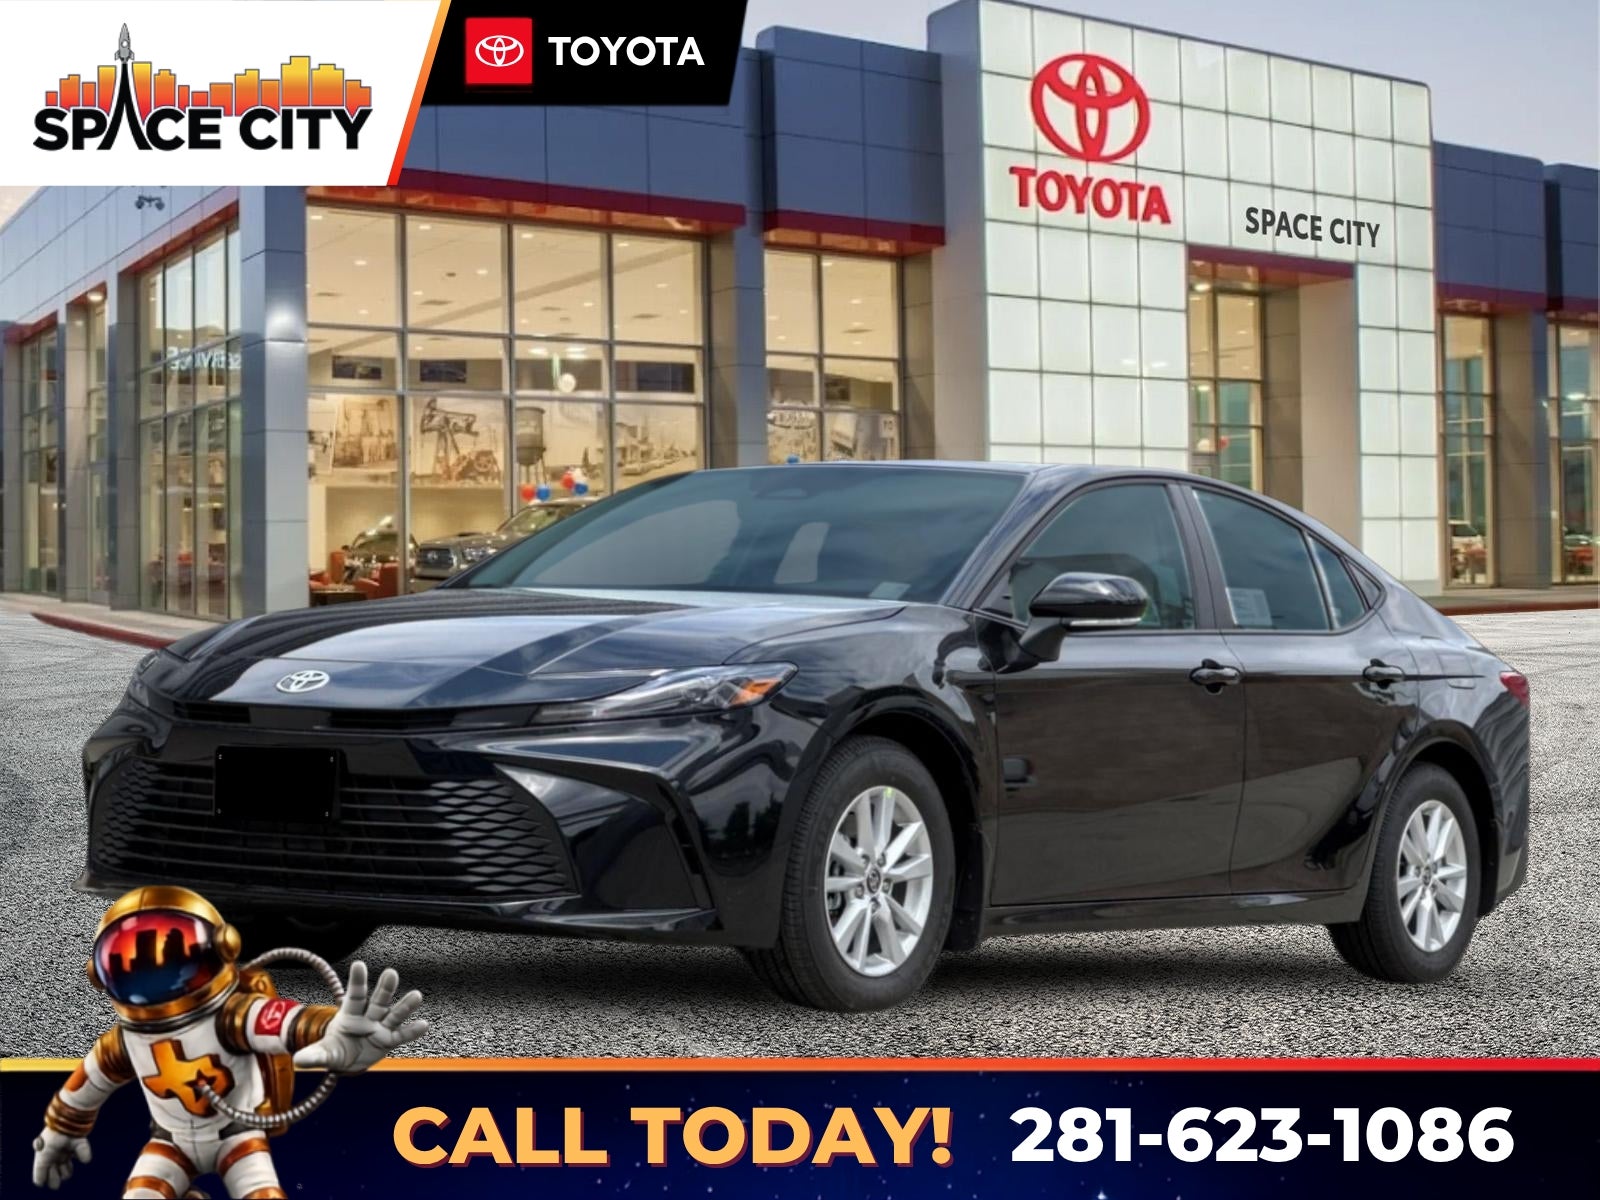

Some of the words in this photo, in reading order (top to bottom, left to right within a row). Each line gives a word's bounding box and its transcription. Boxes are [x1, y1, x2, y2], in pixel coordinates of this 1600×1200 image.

[1010, 166, 1171, 225] TOYOTA
[1245, 206, 1323, 242] SPACE
[1330, 217, 1381, 249] CITY
